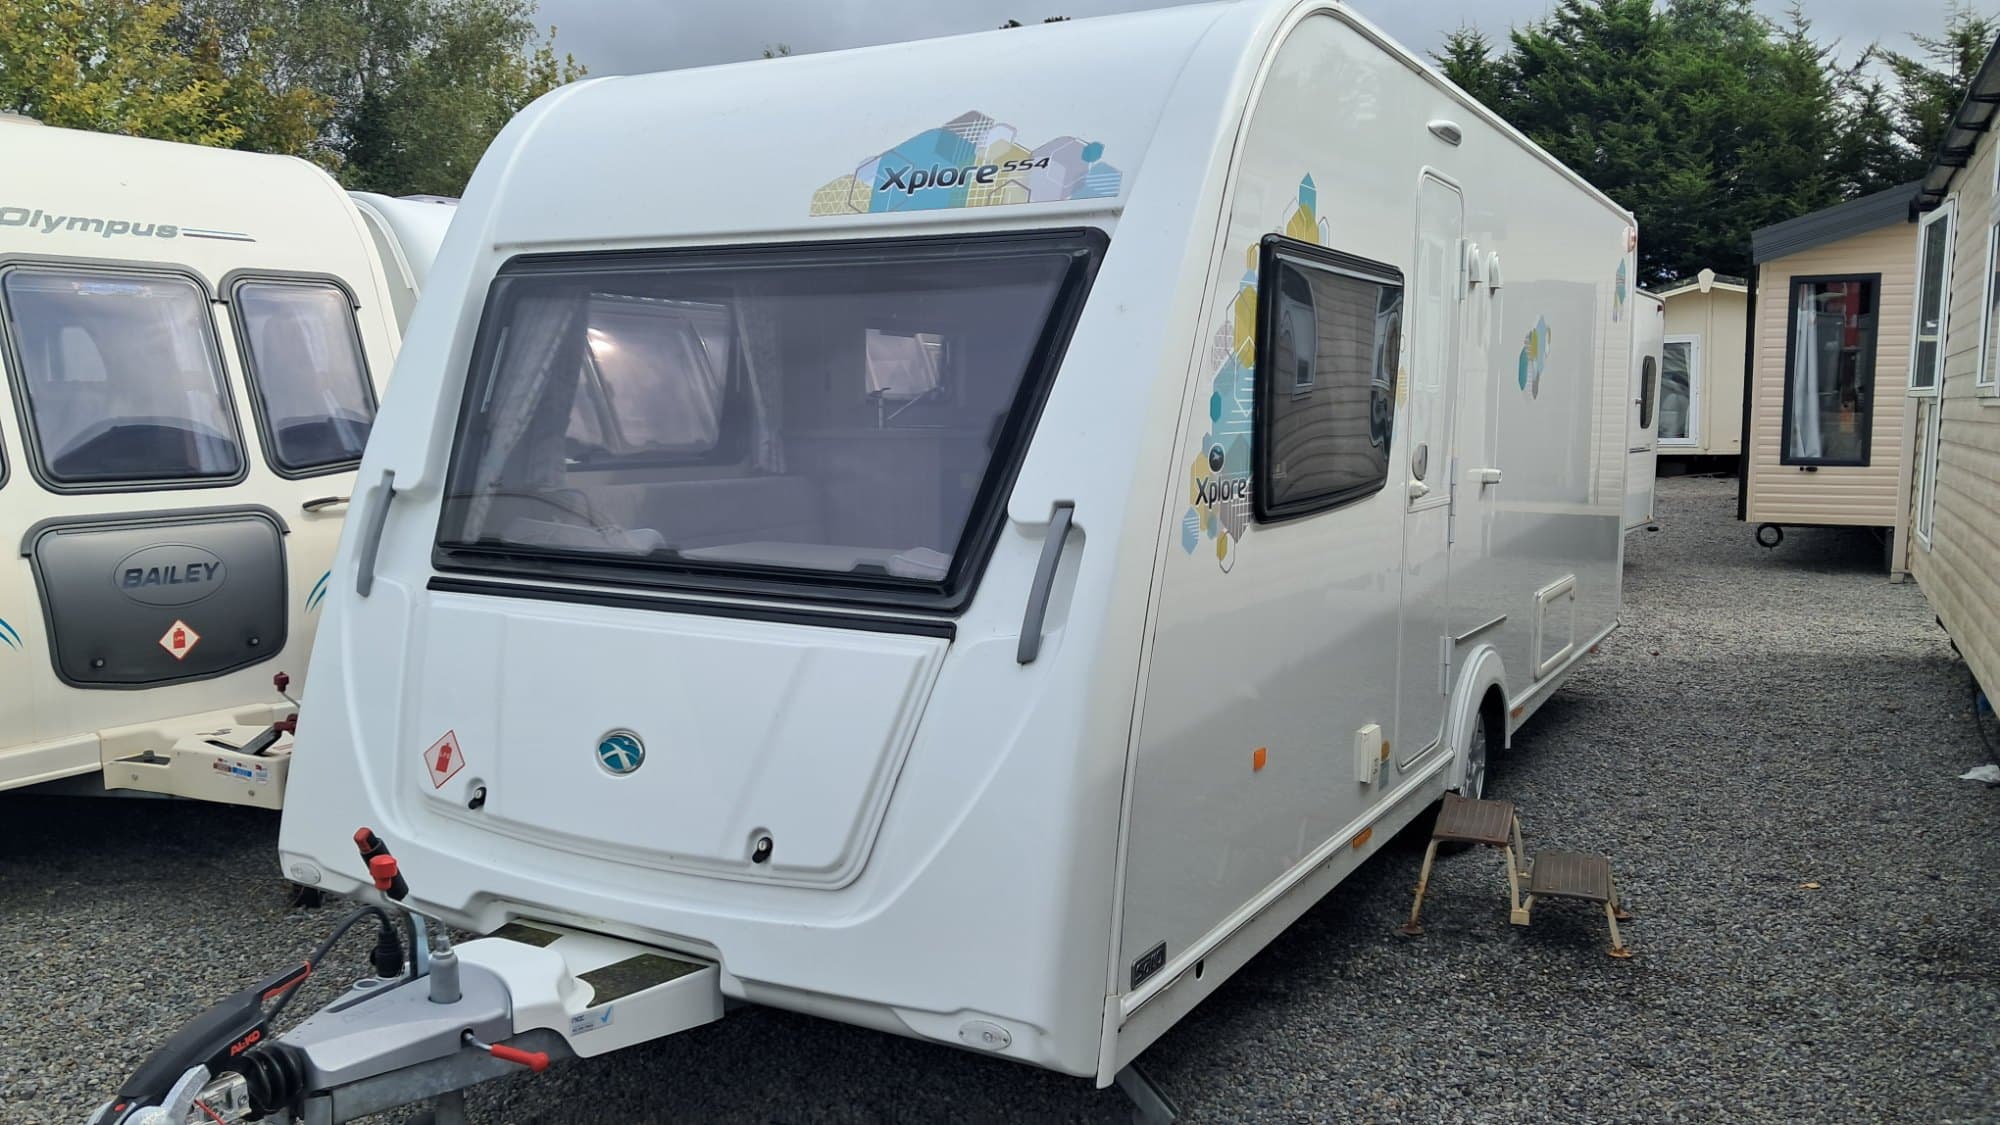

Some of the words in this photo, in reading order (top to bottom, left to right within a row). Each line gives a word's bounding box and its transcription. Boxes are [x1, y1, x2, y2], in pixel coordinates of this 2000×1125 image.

[879, 164, 999, 195] Xplore
[0, 206, 179, 239] Olympus
[1195, 476, 1247, 509] Xplore
[122, 561, 220, 588] BAILEY
